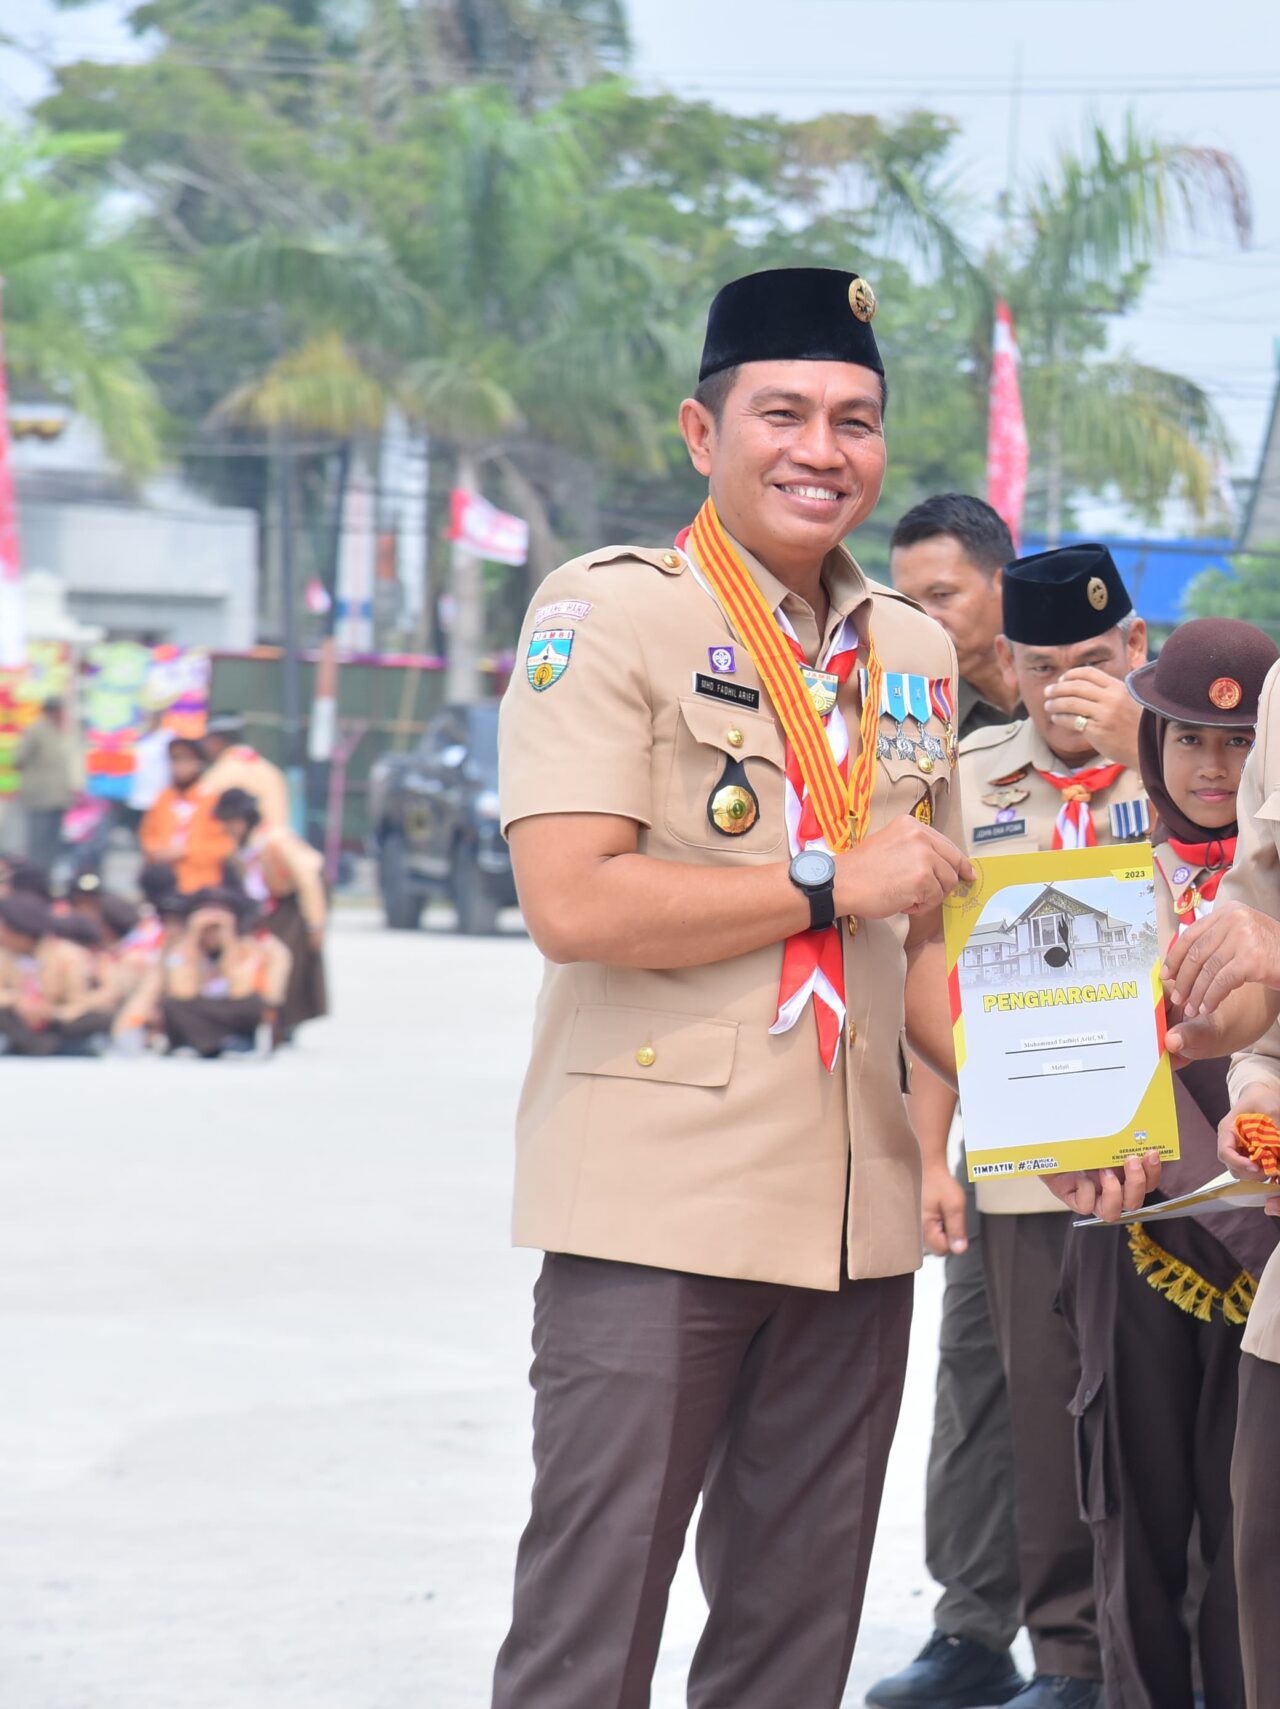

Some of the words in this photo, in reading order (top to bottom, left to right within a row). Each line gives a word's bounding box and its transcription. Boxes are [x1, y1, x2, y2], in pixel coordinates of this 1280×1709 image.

[536, 632, 571, 640] JAMBI
[738, 690, 755, 702] ARIEF
[1124, 870, 1146, 879] 2023
[983, 981, 1138, 1012] PENGHARGAAN
